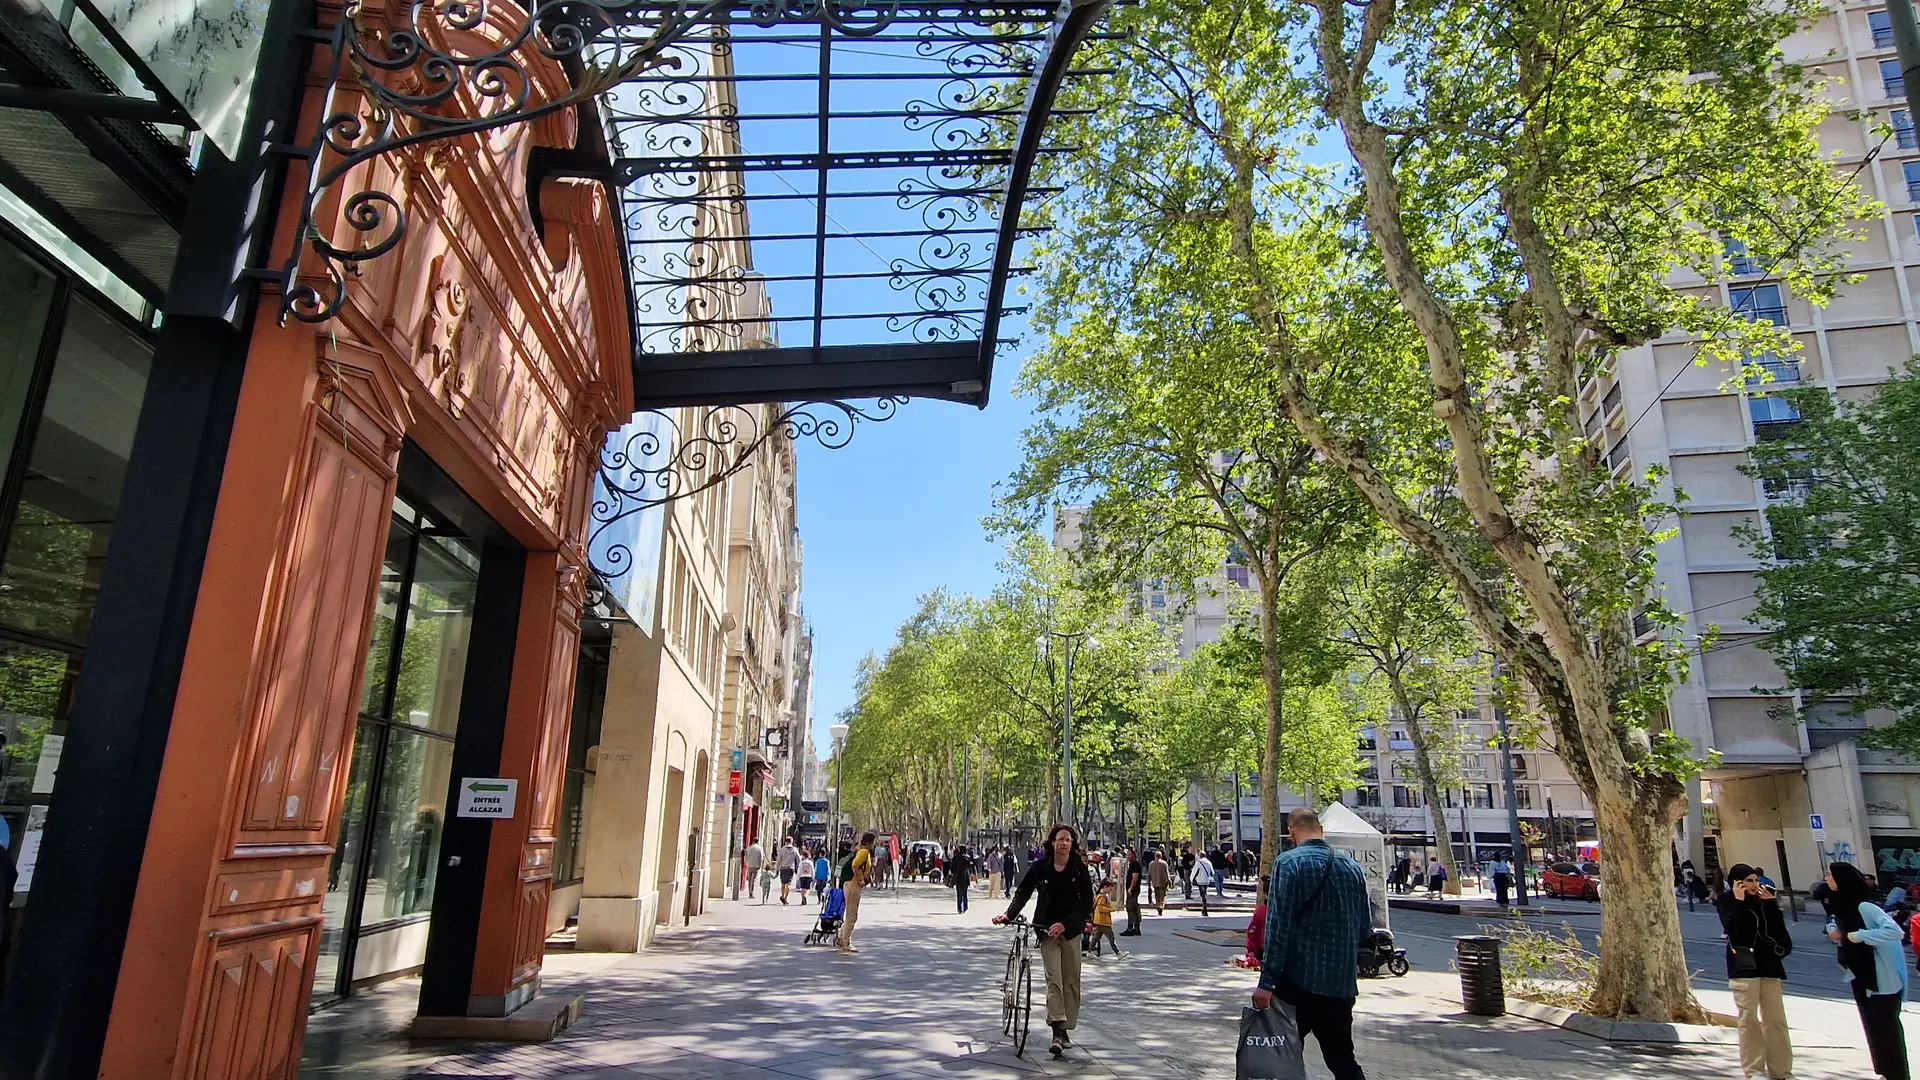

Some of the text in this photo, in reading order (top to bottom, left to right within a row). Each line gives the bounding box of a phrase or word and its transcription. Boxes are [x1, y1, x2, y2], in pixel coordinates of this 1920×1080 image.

[730, 777, 740, 788] SFR
[473, 796, 501, 804] ENTRÉE
[469, 806, 503, 814] ALCAZAR
[1246, 1035, 1286, 1047] STARY
